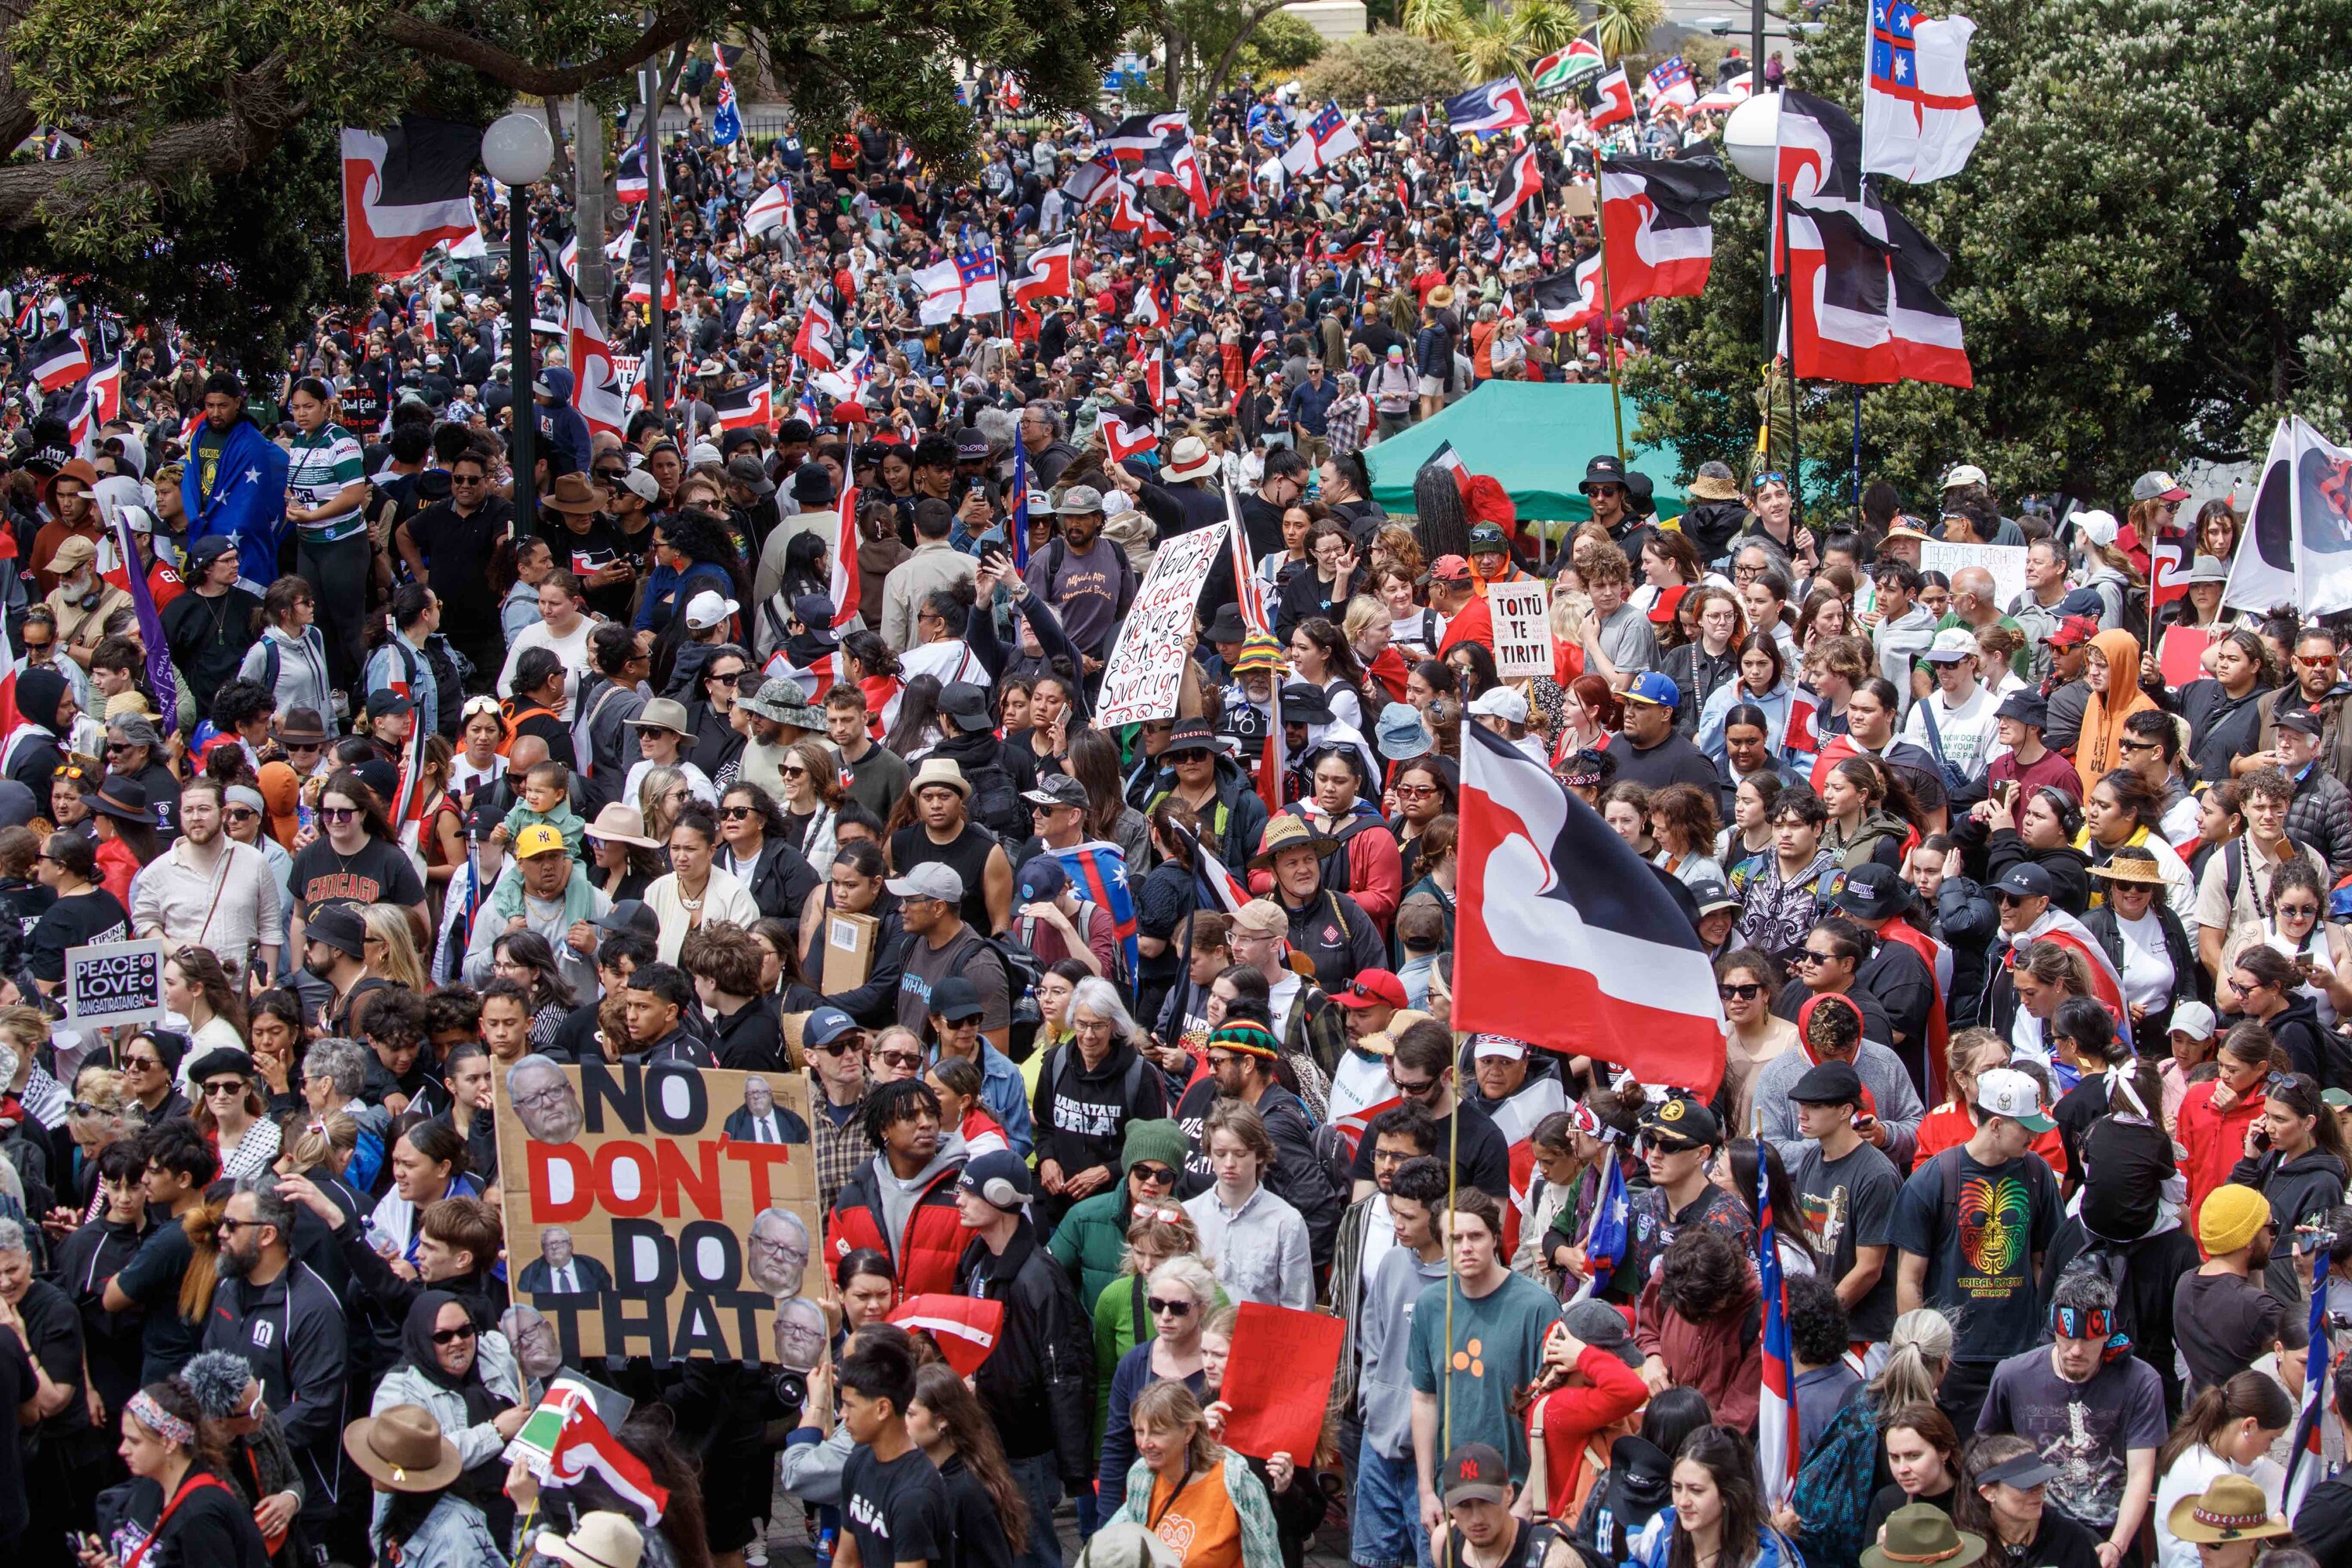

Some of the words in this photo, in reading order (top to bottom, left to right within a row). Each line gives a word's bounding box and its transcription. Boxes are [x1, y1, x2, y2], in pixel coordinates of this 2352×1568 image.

[612, 359, 639, 372] POLIT
[1148, 544, 1203, 587] Never
[1961, 547, 1972, 564] IS
[1980, 548, 2019, 565] RIGHTS
[1094, 584, 1112, 601] Beach
[1497, 593, 1543, 617] TOITŪ
[1510, 620, 1528, 639] TE
[1501, 644, 1546, 664] TIRITI
[1099, 666, 1180, 710] Sovereign
[306, 873, 379, 906] CHICAGO
[76, 955, 140, 980] PEACE
[78, 973, 140, 999] LOVE
[77, 993, 145, 1016] RANGATIRATANGA
[579, 1052, 709, 1136] NO
[1053, 1106, 1117, 1136] ORA
[525, 1131, 789, 1224] DON'T
[611, 1217, 742, 1299] DO
[1957, 1277, 1992, 1287] TRIBAL
[1994, 1277, 2024, 1287] ROOTS
[1970, 1288, 2012, 1298] AOTEAROA
[532, 1289, 776, 1370] THAT
